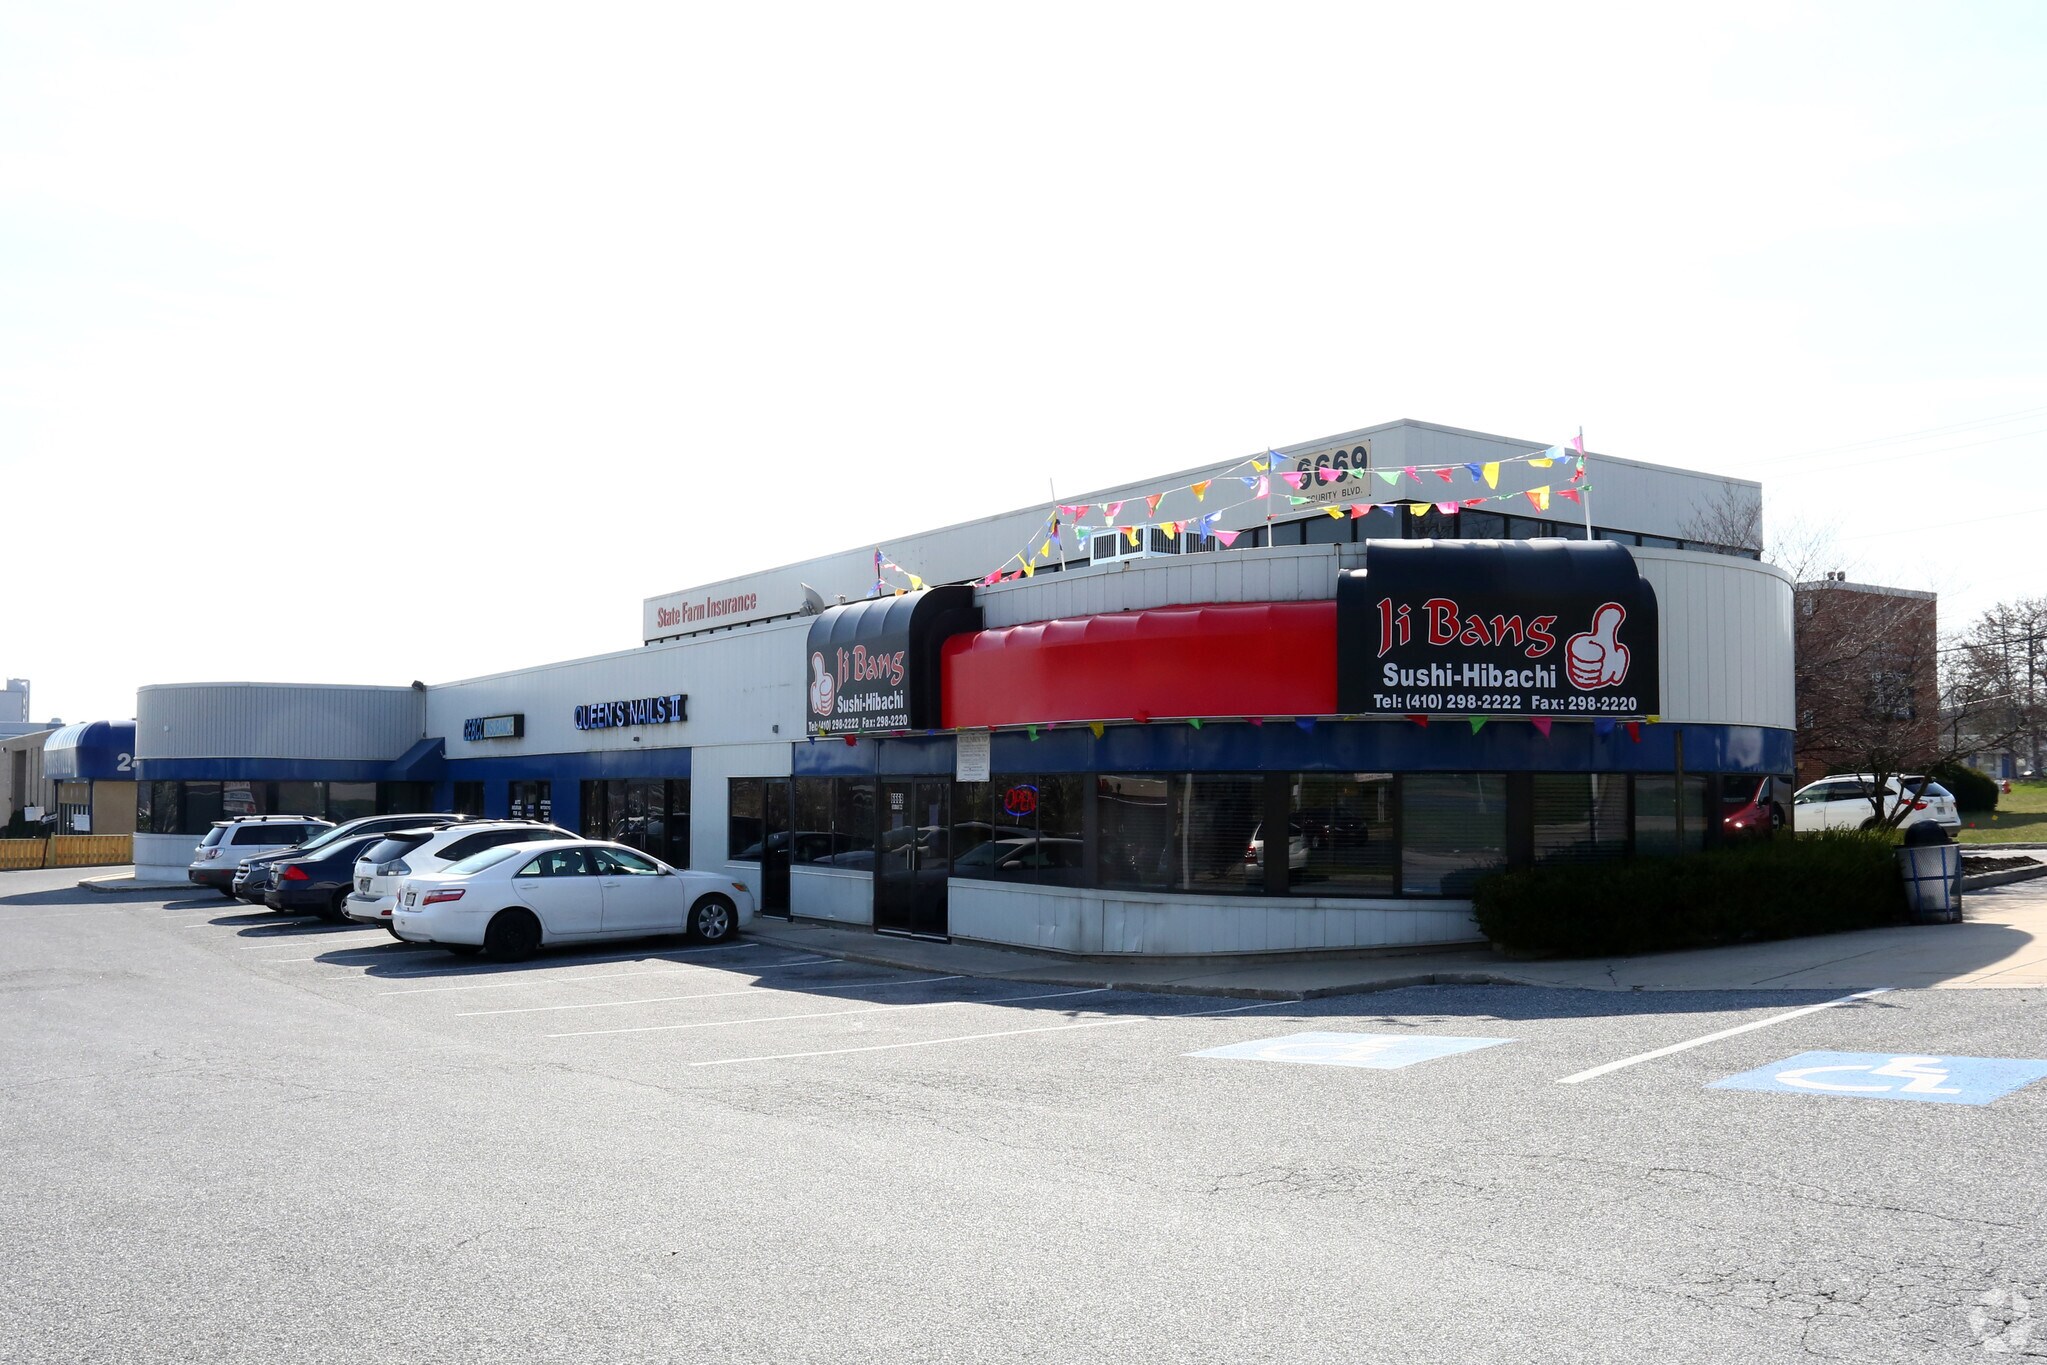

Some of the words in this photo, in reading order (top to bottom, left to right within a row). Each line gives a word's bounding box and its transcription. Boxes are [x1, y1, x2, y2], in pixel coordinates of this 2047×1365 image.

[1297, 446, 1367, 490] 6669
[1302, 491, 1337, 504] ECURITY
[1342, 486, 1363, 497] BLVD.
[657, 607, 680, 628] State
[682, 602, 705, 623] Farm
[707, 592, 757, 618] Insurance
[1377, 597, 1411, 658] Ji
[1422, 598, 1557, 658] Bang
[836, 647, 850, 693] Ji
[852, 645, 905, 686] Bang
[1383, 662, 1556, 688] Sushi-Hibachi
[574, 701, 625, 730] QUEEN'S
[630, 696, 666, 725] NAILS
[837, 690, 904, 713] Sushi-Hibachi
[1373, 694, 1402, 708] Tel:
[1406, 694, 1442, 710] (410)
[1446, 694, 1521, 710] 298-2222
[1531, 696, 1564, 710] Fax:
[1568, 696, 1637, 711] 298-2220
[832, 718, 859, 730] 298-2222
[862, 717, 875, 728] Fax:
[876, 714, 908, 727] 298-2220
[117, 753, 136, 771] 2
[1005, 788, 1037, 811] OPEN
